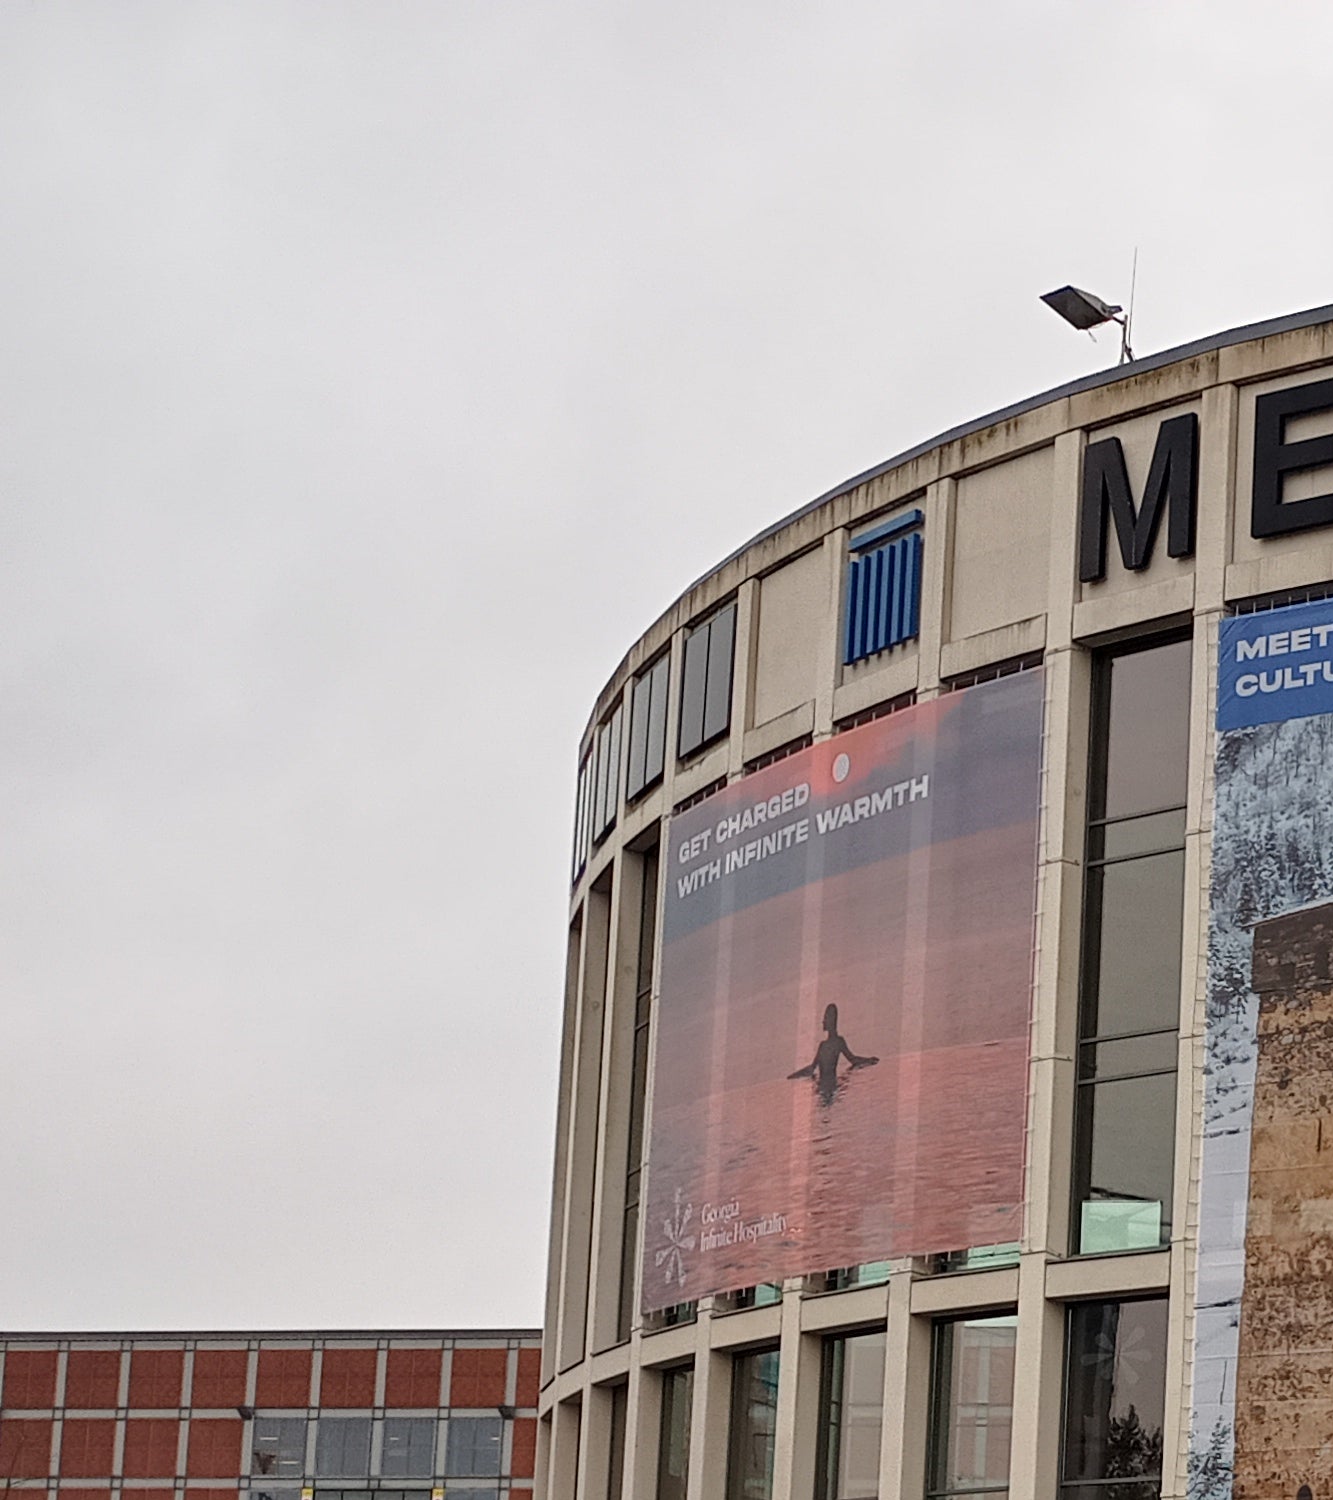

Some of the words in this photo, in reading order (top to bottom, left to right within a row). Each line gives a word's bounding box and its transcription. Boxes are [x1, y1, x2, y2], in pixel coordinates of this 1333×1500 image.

[677, 862, 721, 898] WITH
[725, 819, 809, 874] INFINITE
[816, 774, 929, 834] WARMTH
[678, 828, 711, 864] GET
[716, 783, 810, 844] CHARGED
[700, 1228, 733, 1252] Infinite
[734, 1212, 788, 1243] Hospitality
[702, 1197, 740, 1224] Georgia
